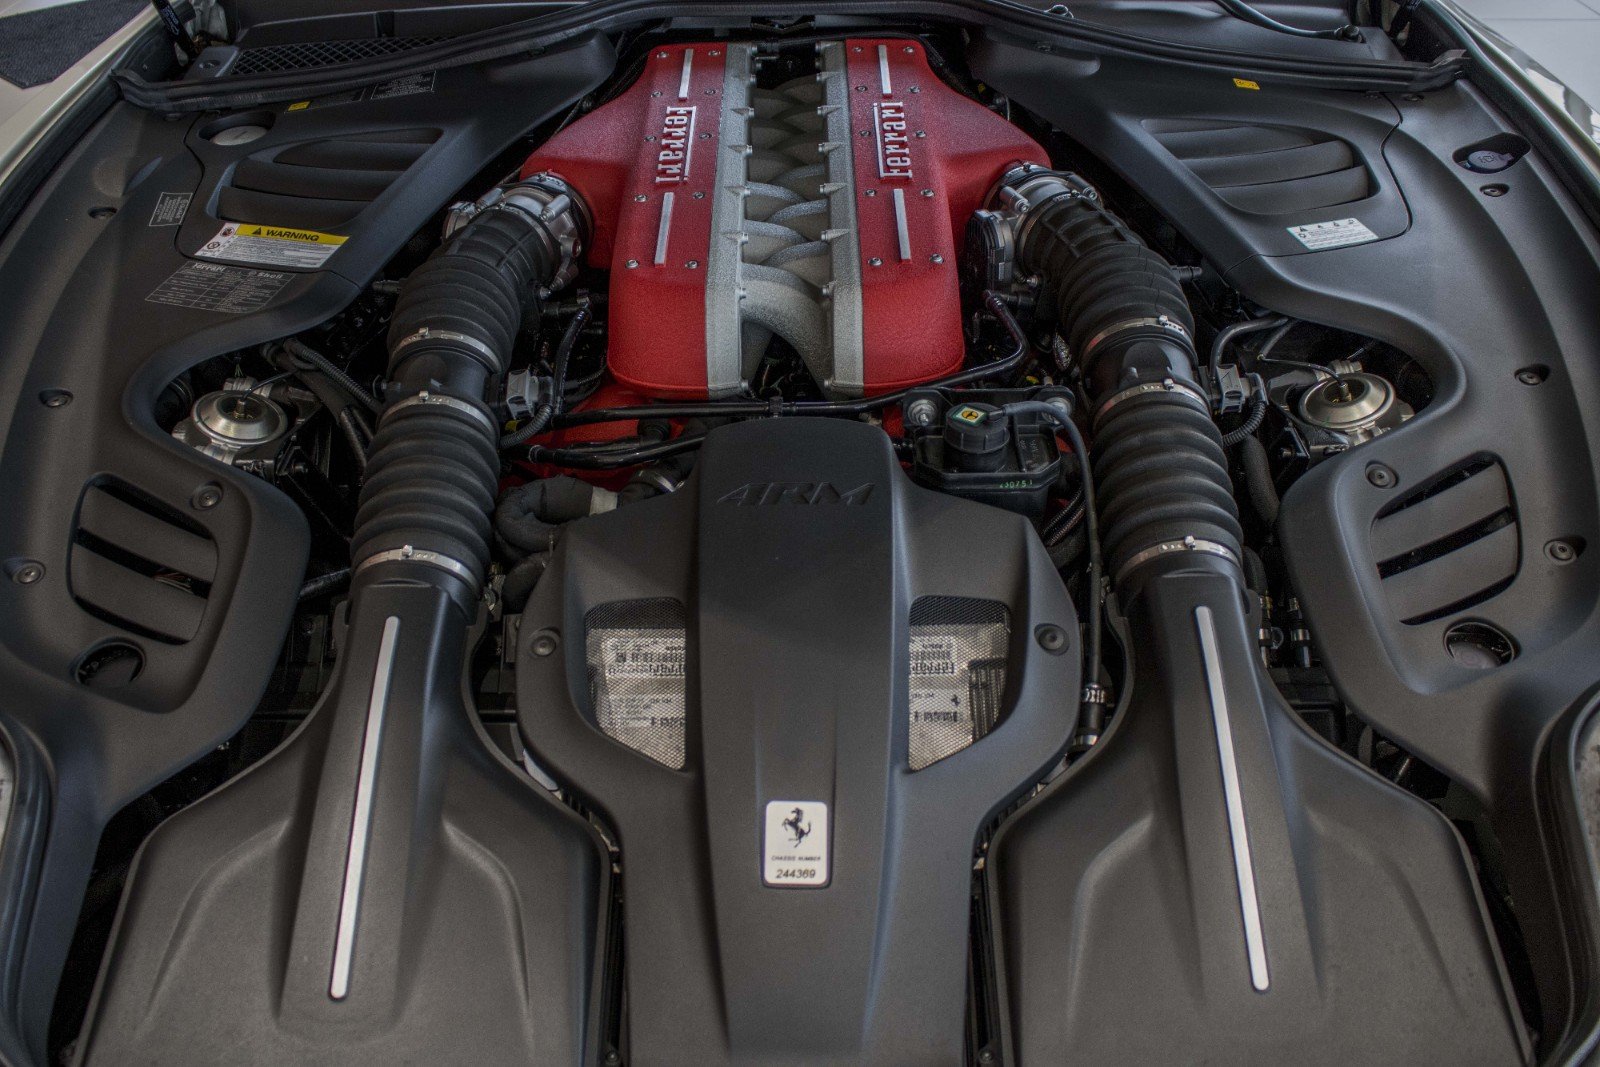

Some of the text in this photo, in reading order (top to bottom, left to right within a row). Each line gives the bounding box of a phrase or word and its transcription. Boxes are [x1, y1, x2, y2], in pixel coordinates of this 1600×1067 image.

[656, 105, 697, 183] Ferrari
[873, 101, 913, 179] Ferrari
[266, 229, 320, 242] WARNING
[775, 868, 816, 879] 244369
